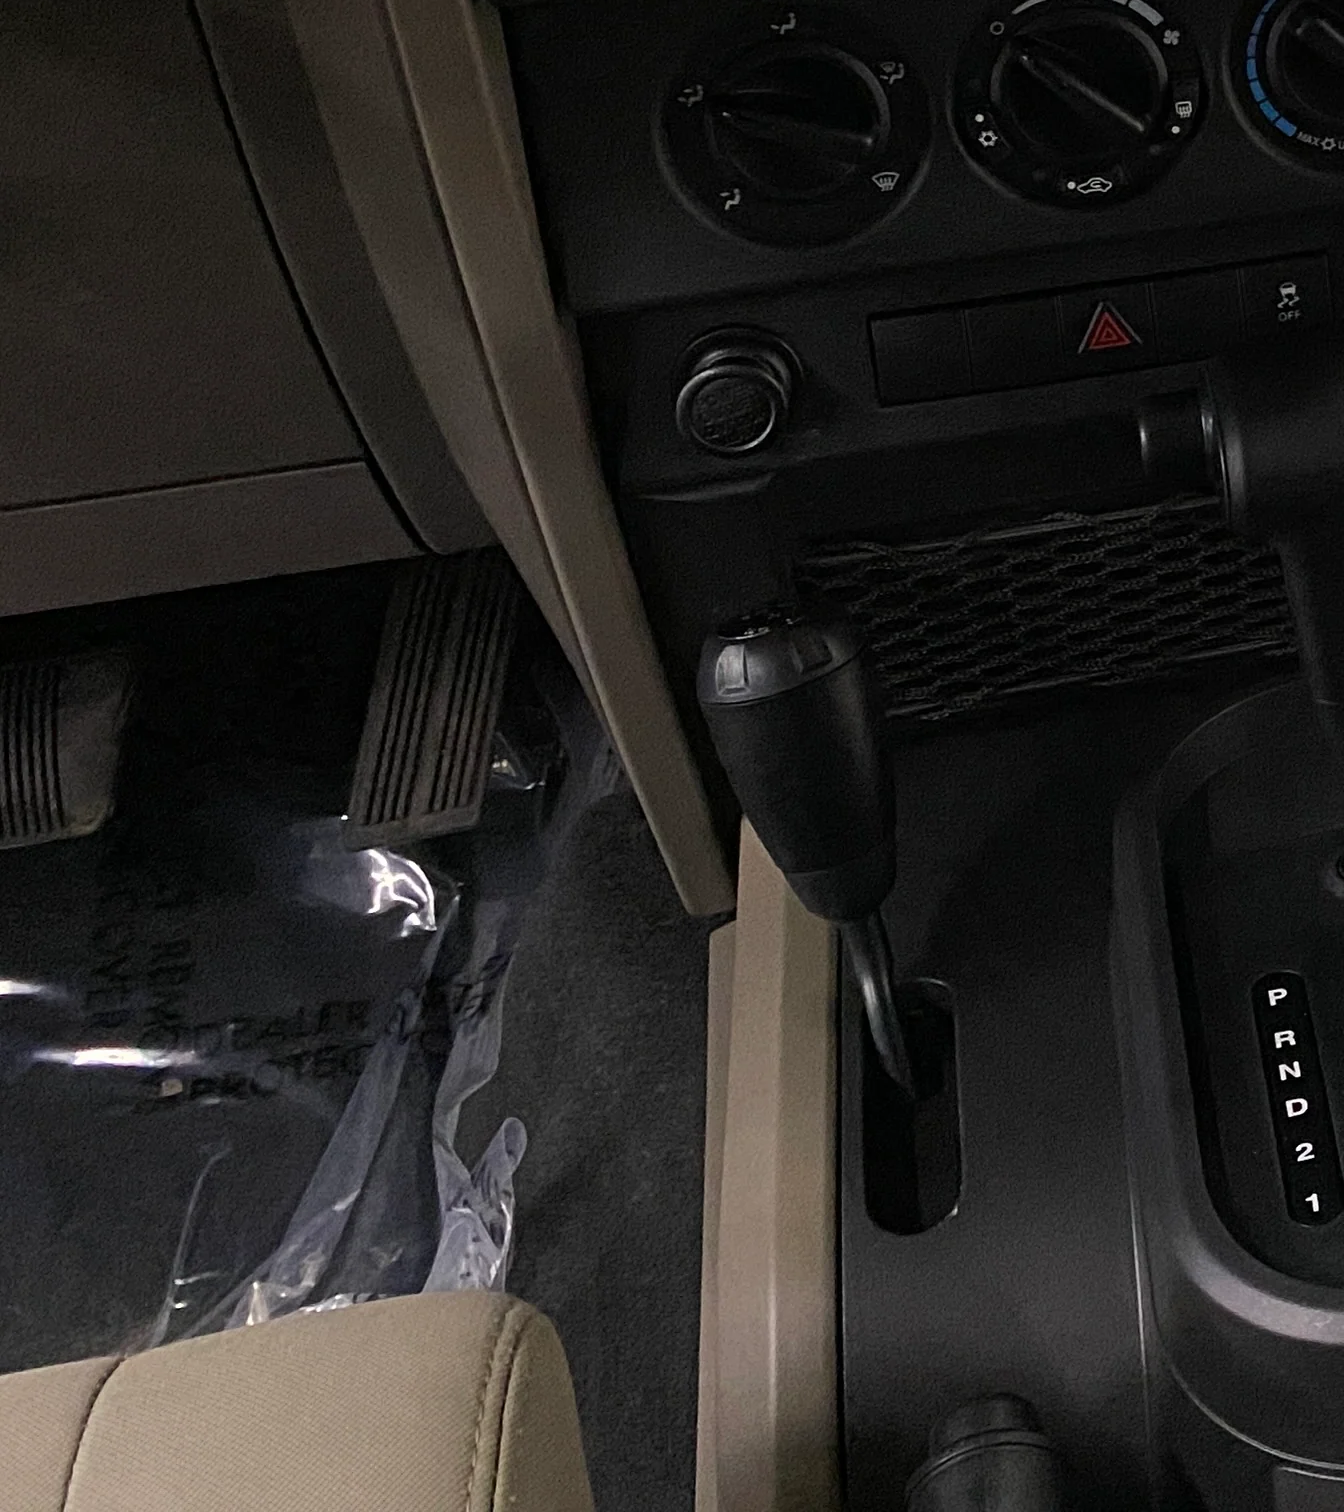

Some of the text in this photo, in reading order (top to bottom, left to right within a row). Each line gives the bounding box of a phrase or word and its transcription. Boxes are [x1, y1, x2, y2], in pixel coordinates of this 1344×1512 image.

[1296, 131, 1321, 148] MAX
[1278, 310, 1302, 322] OFF
[1268, 988, 1288, 1006] P
[1274, 1030, 1296, 1048] R
[1278, 1061, 1301, 1081] N
[1285, 1098, 1309, 1118] D
[1295, 1142, 1315, 1162] 2
[1304, 1193, 1320, 1212] 1
